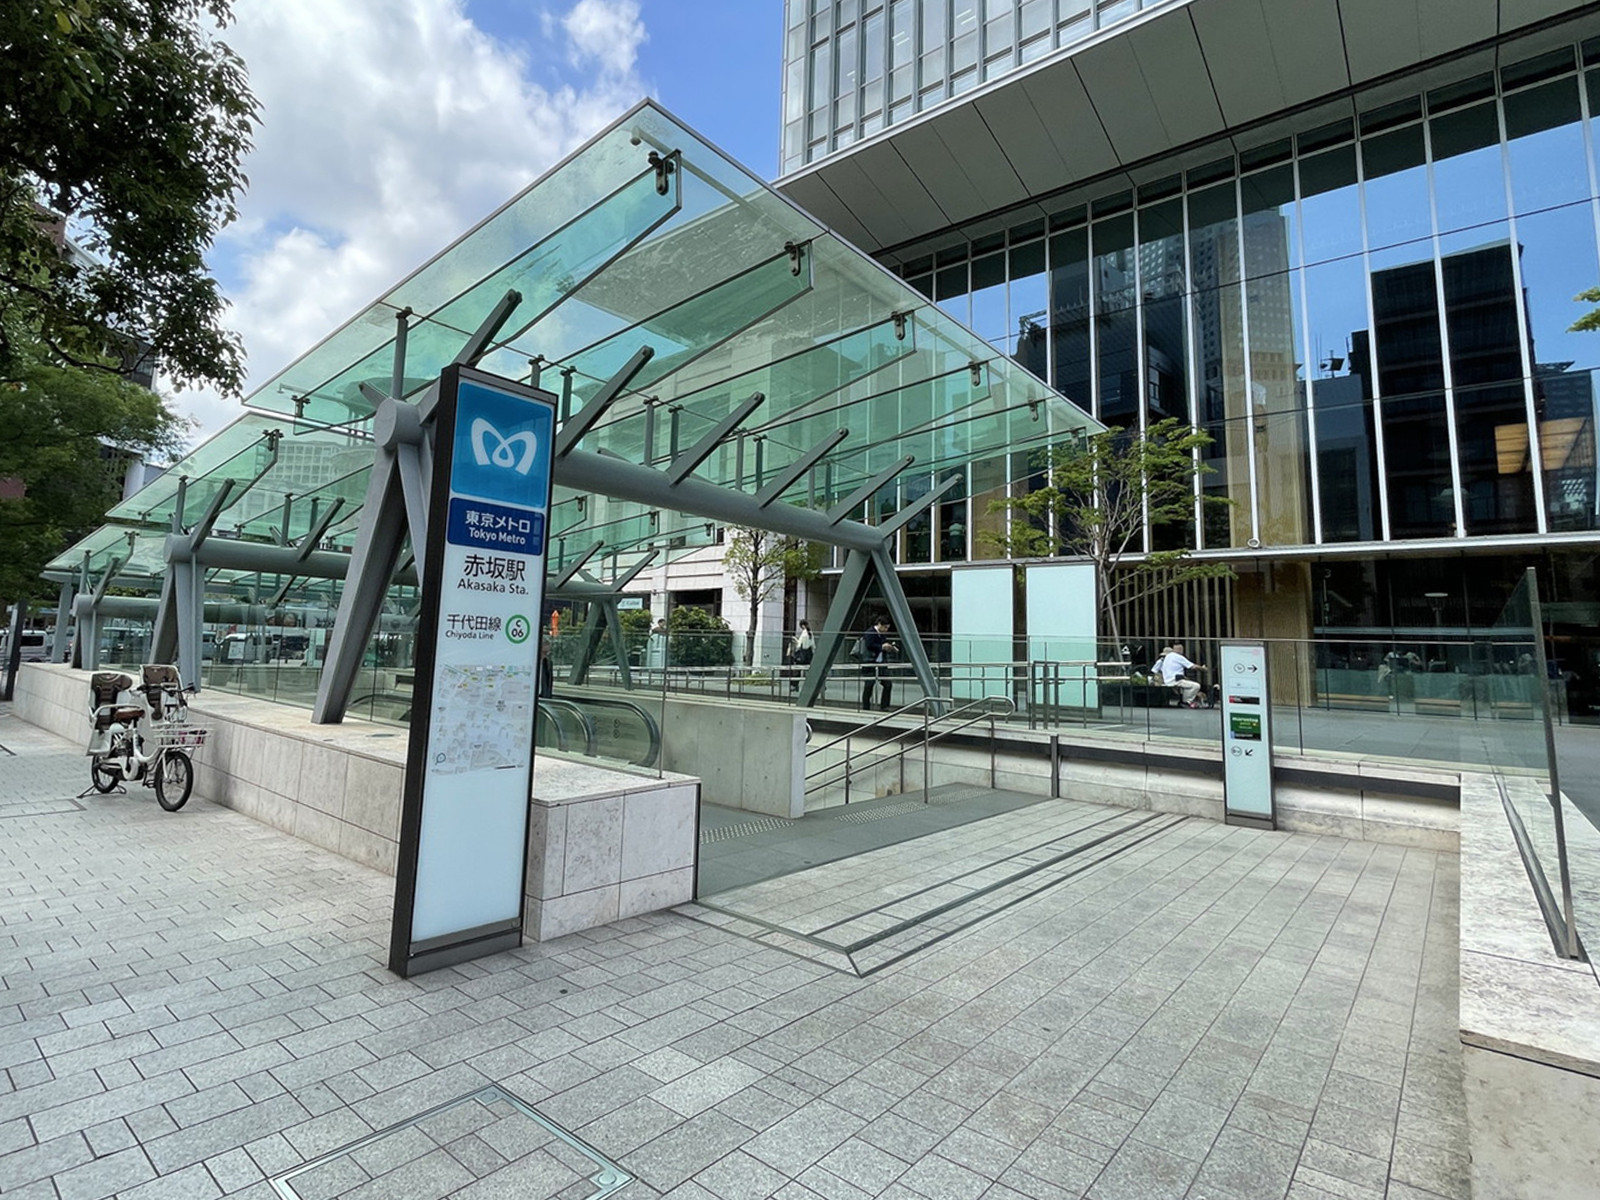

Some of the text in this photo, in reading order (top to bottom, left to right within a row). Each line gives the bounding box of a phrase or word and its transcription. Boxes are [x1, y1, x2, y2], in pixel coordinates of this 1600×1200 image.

[464, 510, 531, 534] 東京メトロ
[468, 527, 526, 545] Tokyo Metro
[463, 554, 526, 582] 赤坂駅
[457, 578, 529, 595] Akasaka Sta.
[446, 614, 502, 632] 千代田線
[445, 629, 494, 641] Chiyoda Line
[511, 628, 524, 638] 06
